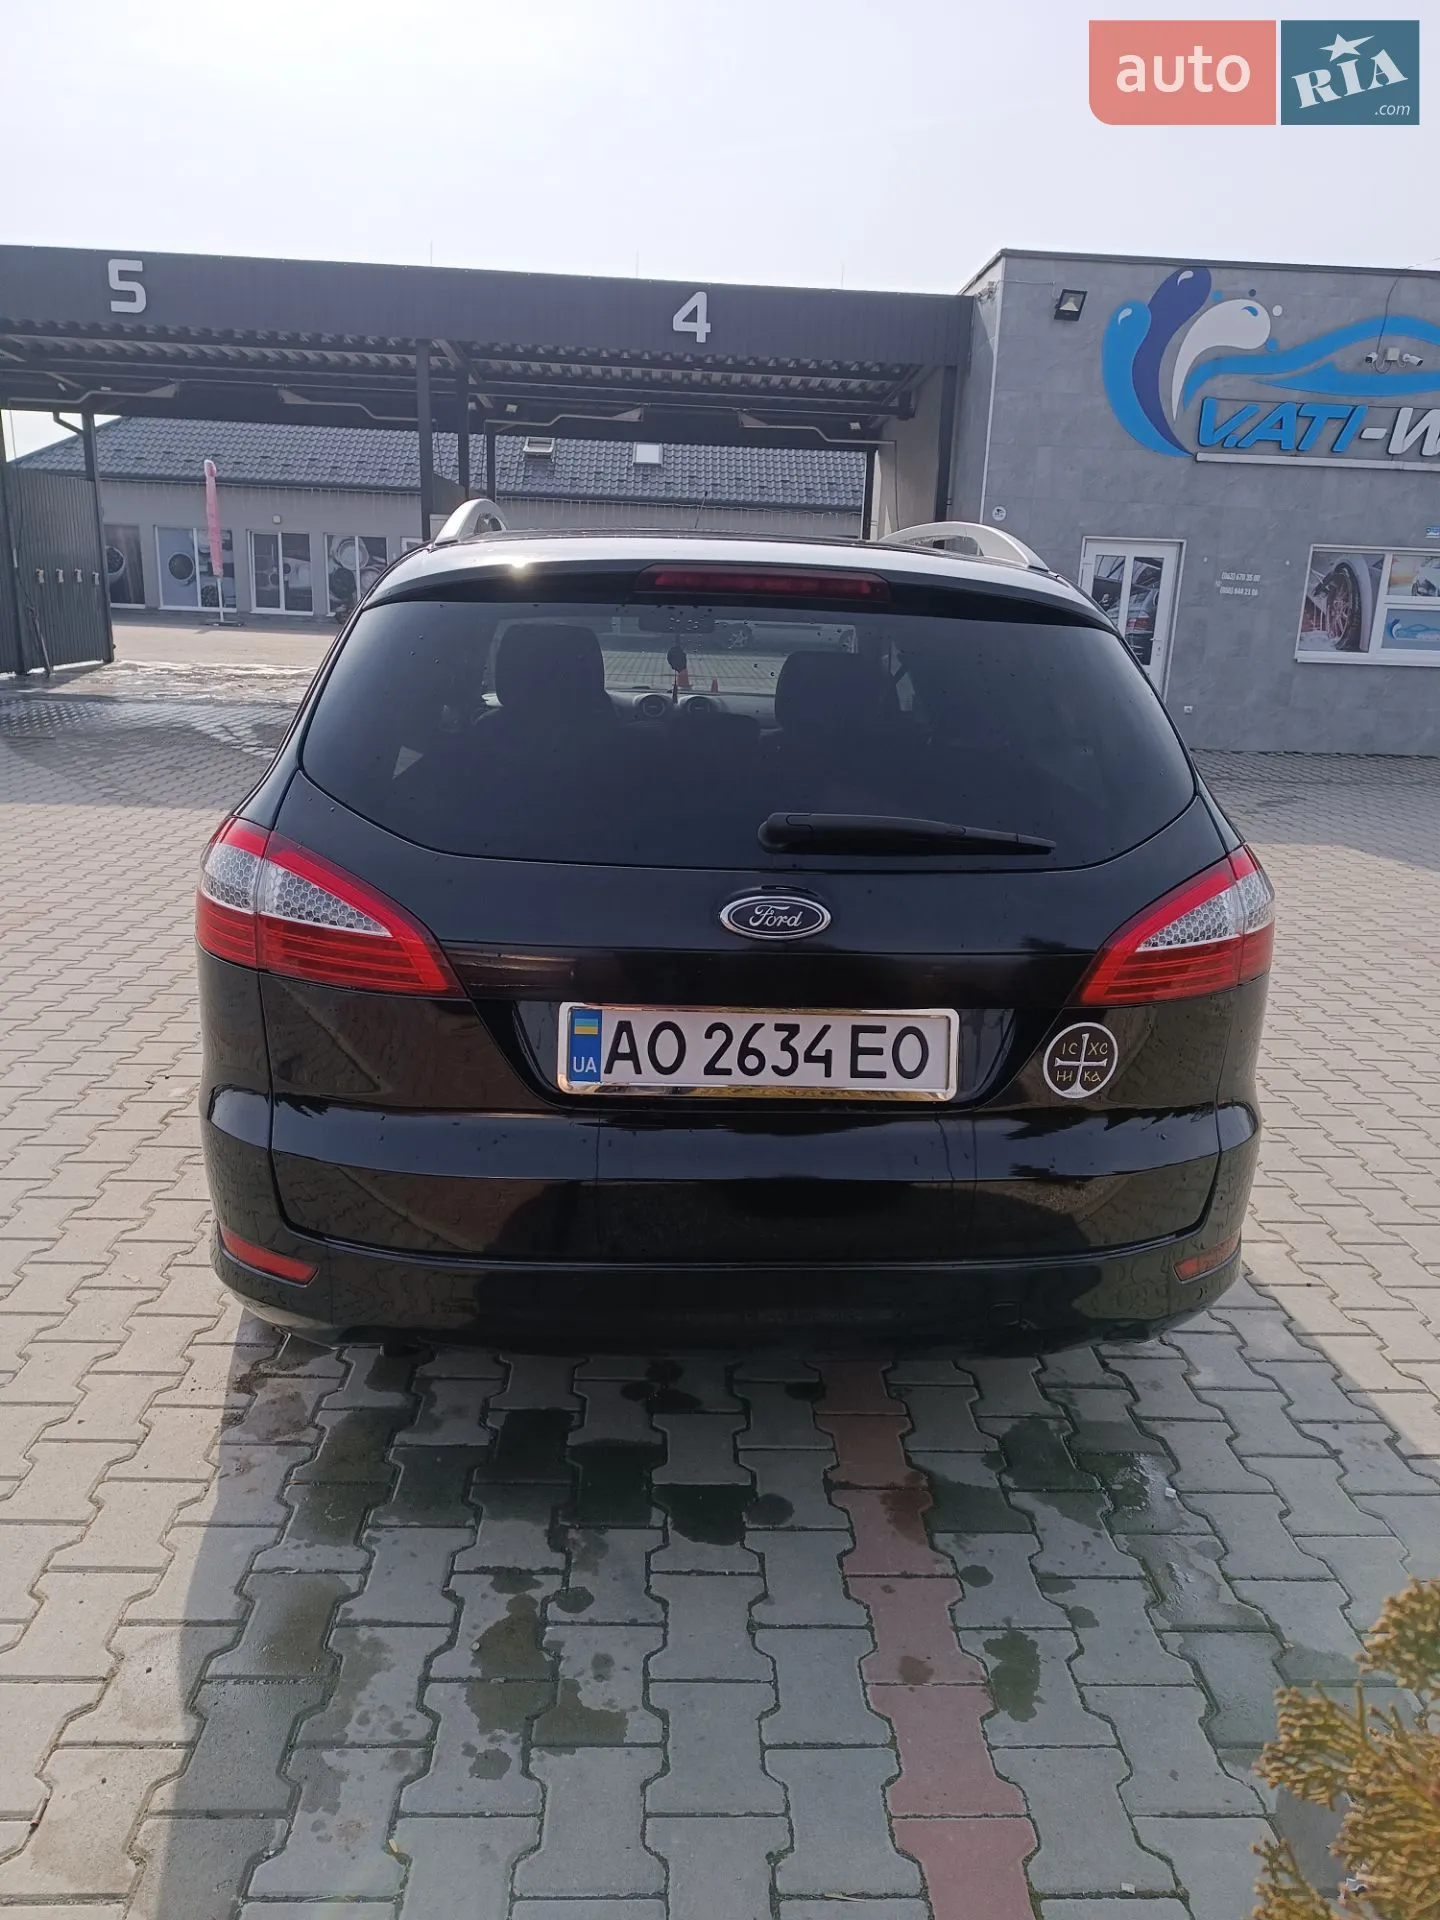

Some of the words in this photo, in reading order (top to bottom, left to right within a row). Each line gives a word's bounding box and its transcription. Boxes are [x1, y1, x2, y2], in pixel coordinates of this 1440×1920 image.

[108, 258, 147, 313] 5
[672, 291, 711, 343] 4
[749, 904, 802, 927] Ford
[573, 1056, 597, 1073] UA
[604, 1020, 687, 1076] AO
[703, 1021, 832, 1078] 2634
[850, 1024, 930, 1079] EO
